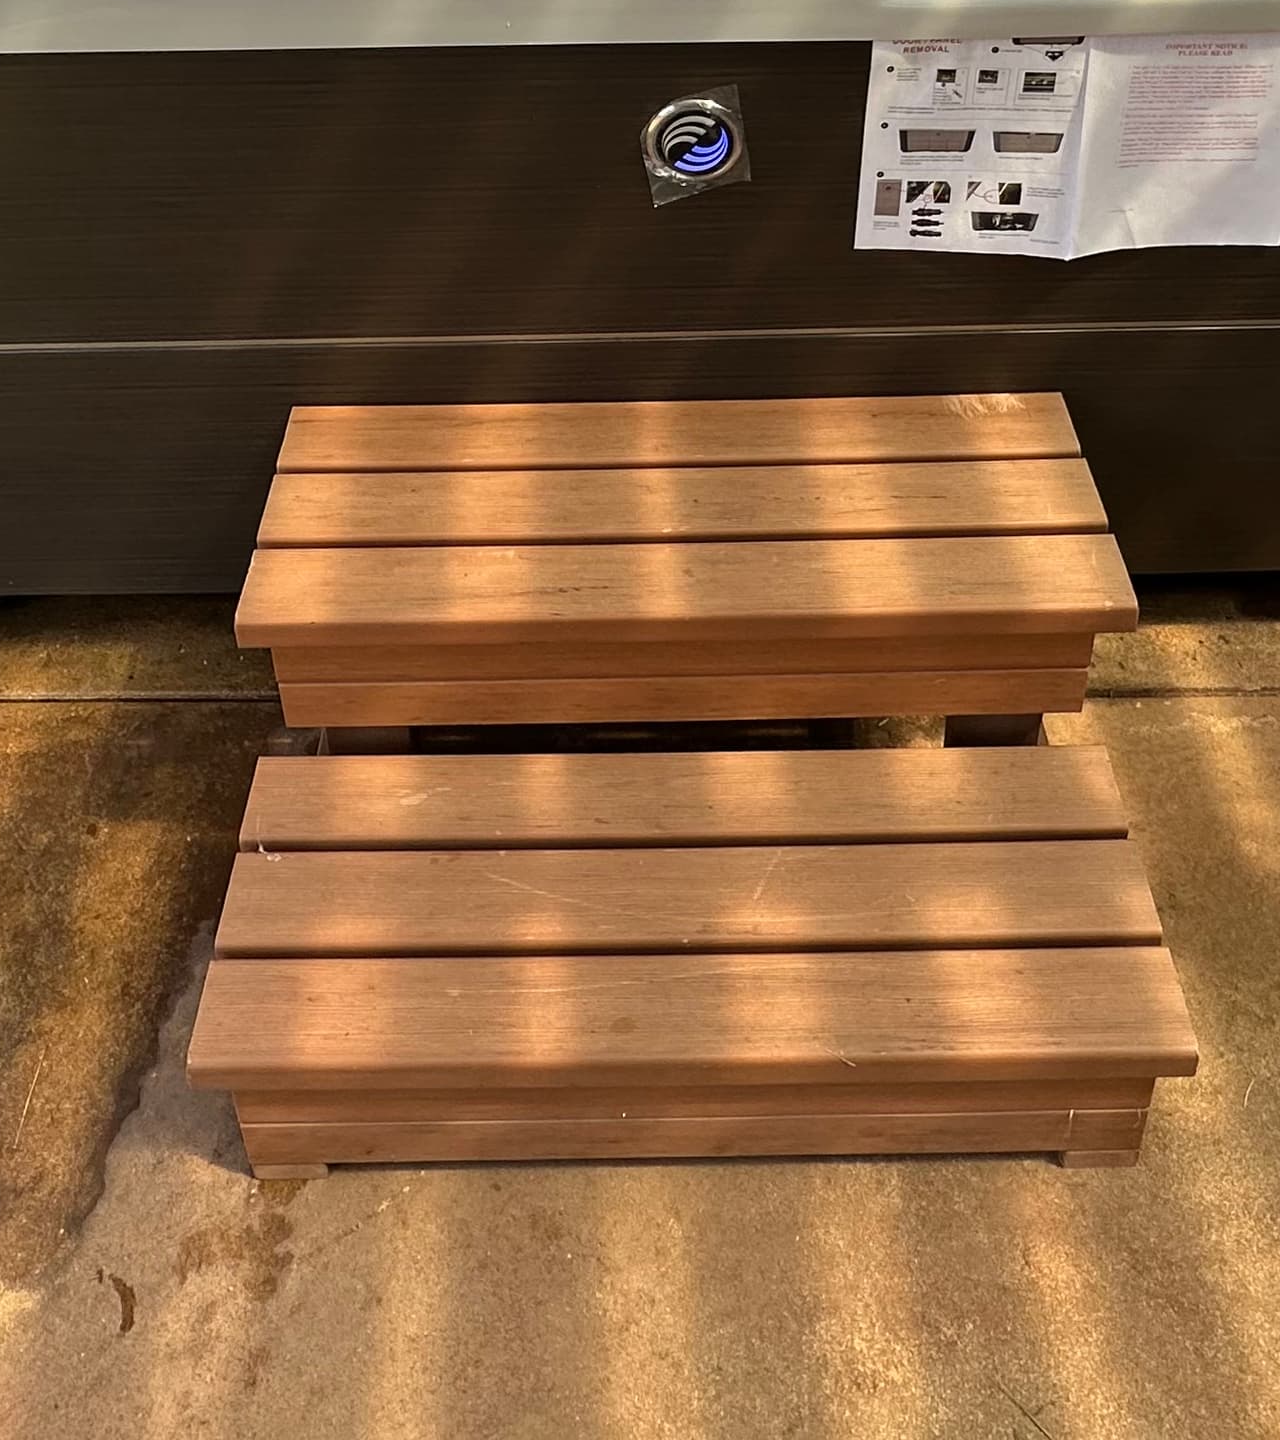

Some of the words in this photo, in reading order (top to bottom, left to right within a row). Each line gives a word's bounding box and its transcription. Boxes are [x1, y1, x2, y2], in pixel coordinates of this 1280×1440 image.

[903, 45, 950, 54] REMOVAL
[1178, 49, 1209, 57] PLEASE
[1210, 49, 1233, 57] READ
